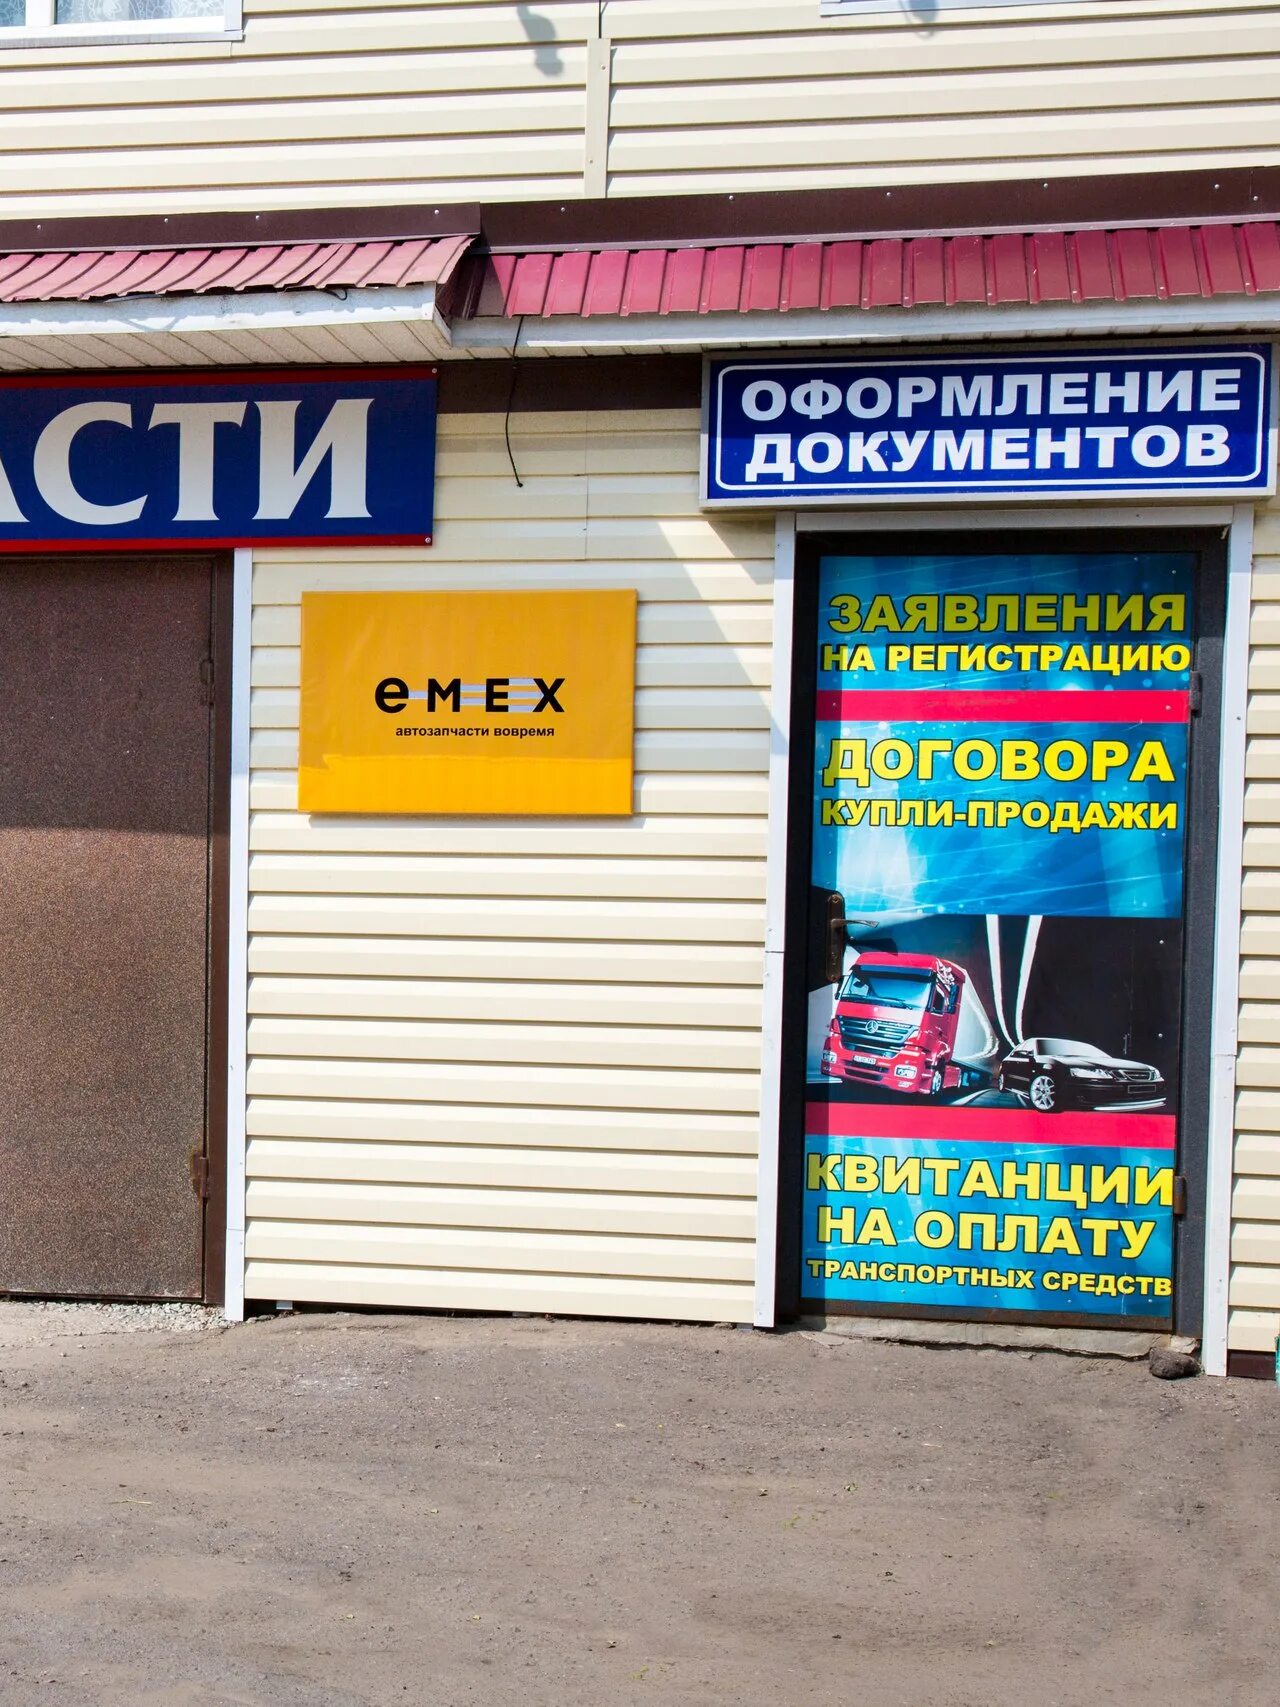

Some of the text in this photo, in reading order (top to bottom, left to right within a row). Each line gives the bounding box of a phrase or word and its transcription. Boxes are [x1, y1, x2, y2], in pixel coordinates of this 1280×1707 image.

[741, 368, 1242, 421] ОФОРМЛЕНИЕ
[744, 423, 1231, 482] ДОКУМЕНТОВ
[828, 593, 1186, 634] ЗАЯВЛЕНИЯ
[822, 644, 1191, 677] НА РЕГИСТРАЦИЮ
[395, 725, 555, 739] автозапчасти вовремя
[822, 738, 1177, 788] ДОГОВОРА
[821, 799, 1178, 834] КУПЛИ-ПРОДАЖИ
[805, 1152, 1175, 1210] КВИТАНЦИИ
[816, 1205, 1157, 1260] НА ОПЛАТУ
[806, 1259, 1173, 1297] ТРАНСПОРТНЫХ СРЕДСТВ
